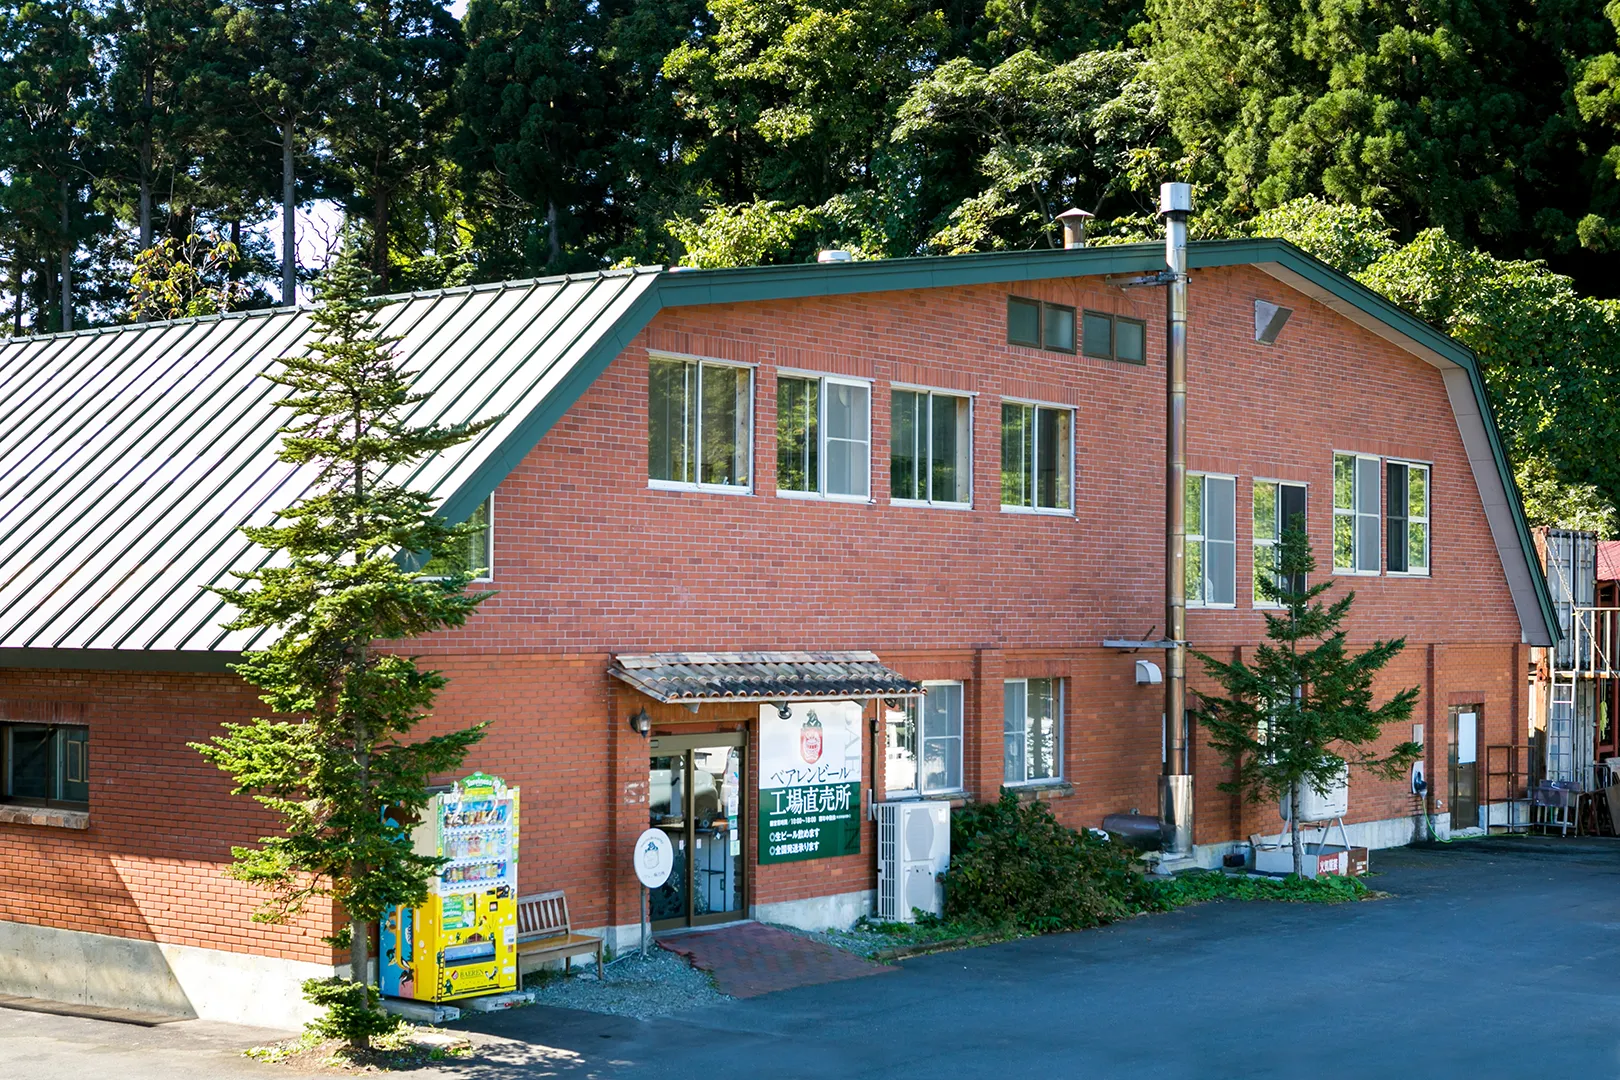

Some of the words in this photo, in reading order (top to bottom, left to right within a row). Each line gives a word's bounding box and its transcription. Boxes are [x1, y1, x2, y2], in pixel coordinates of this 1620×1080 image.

[770, 764, 850, 787] ベアレンビール
[769, 784, 851, 815] 工場直売所
